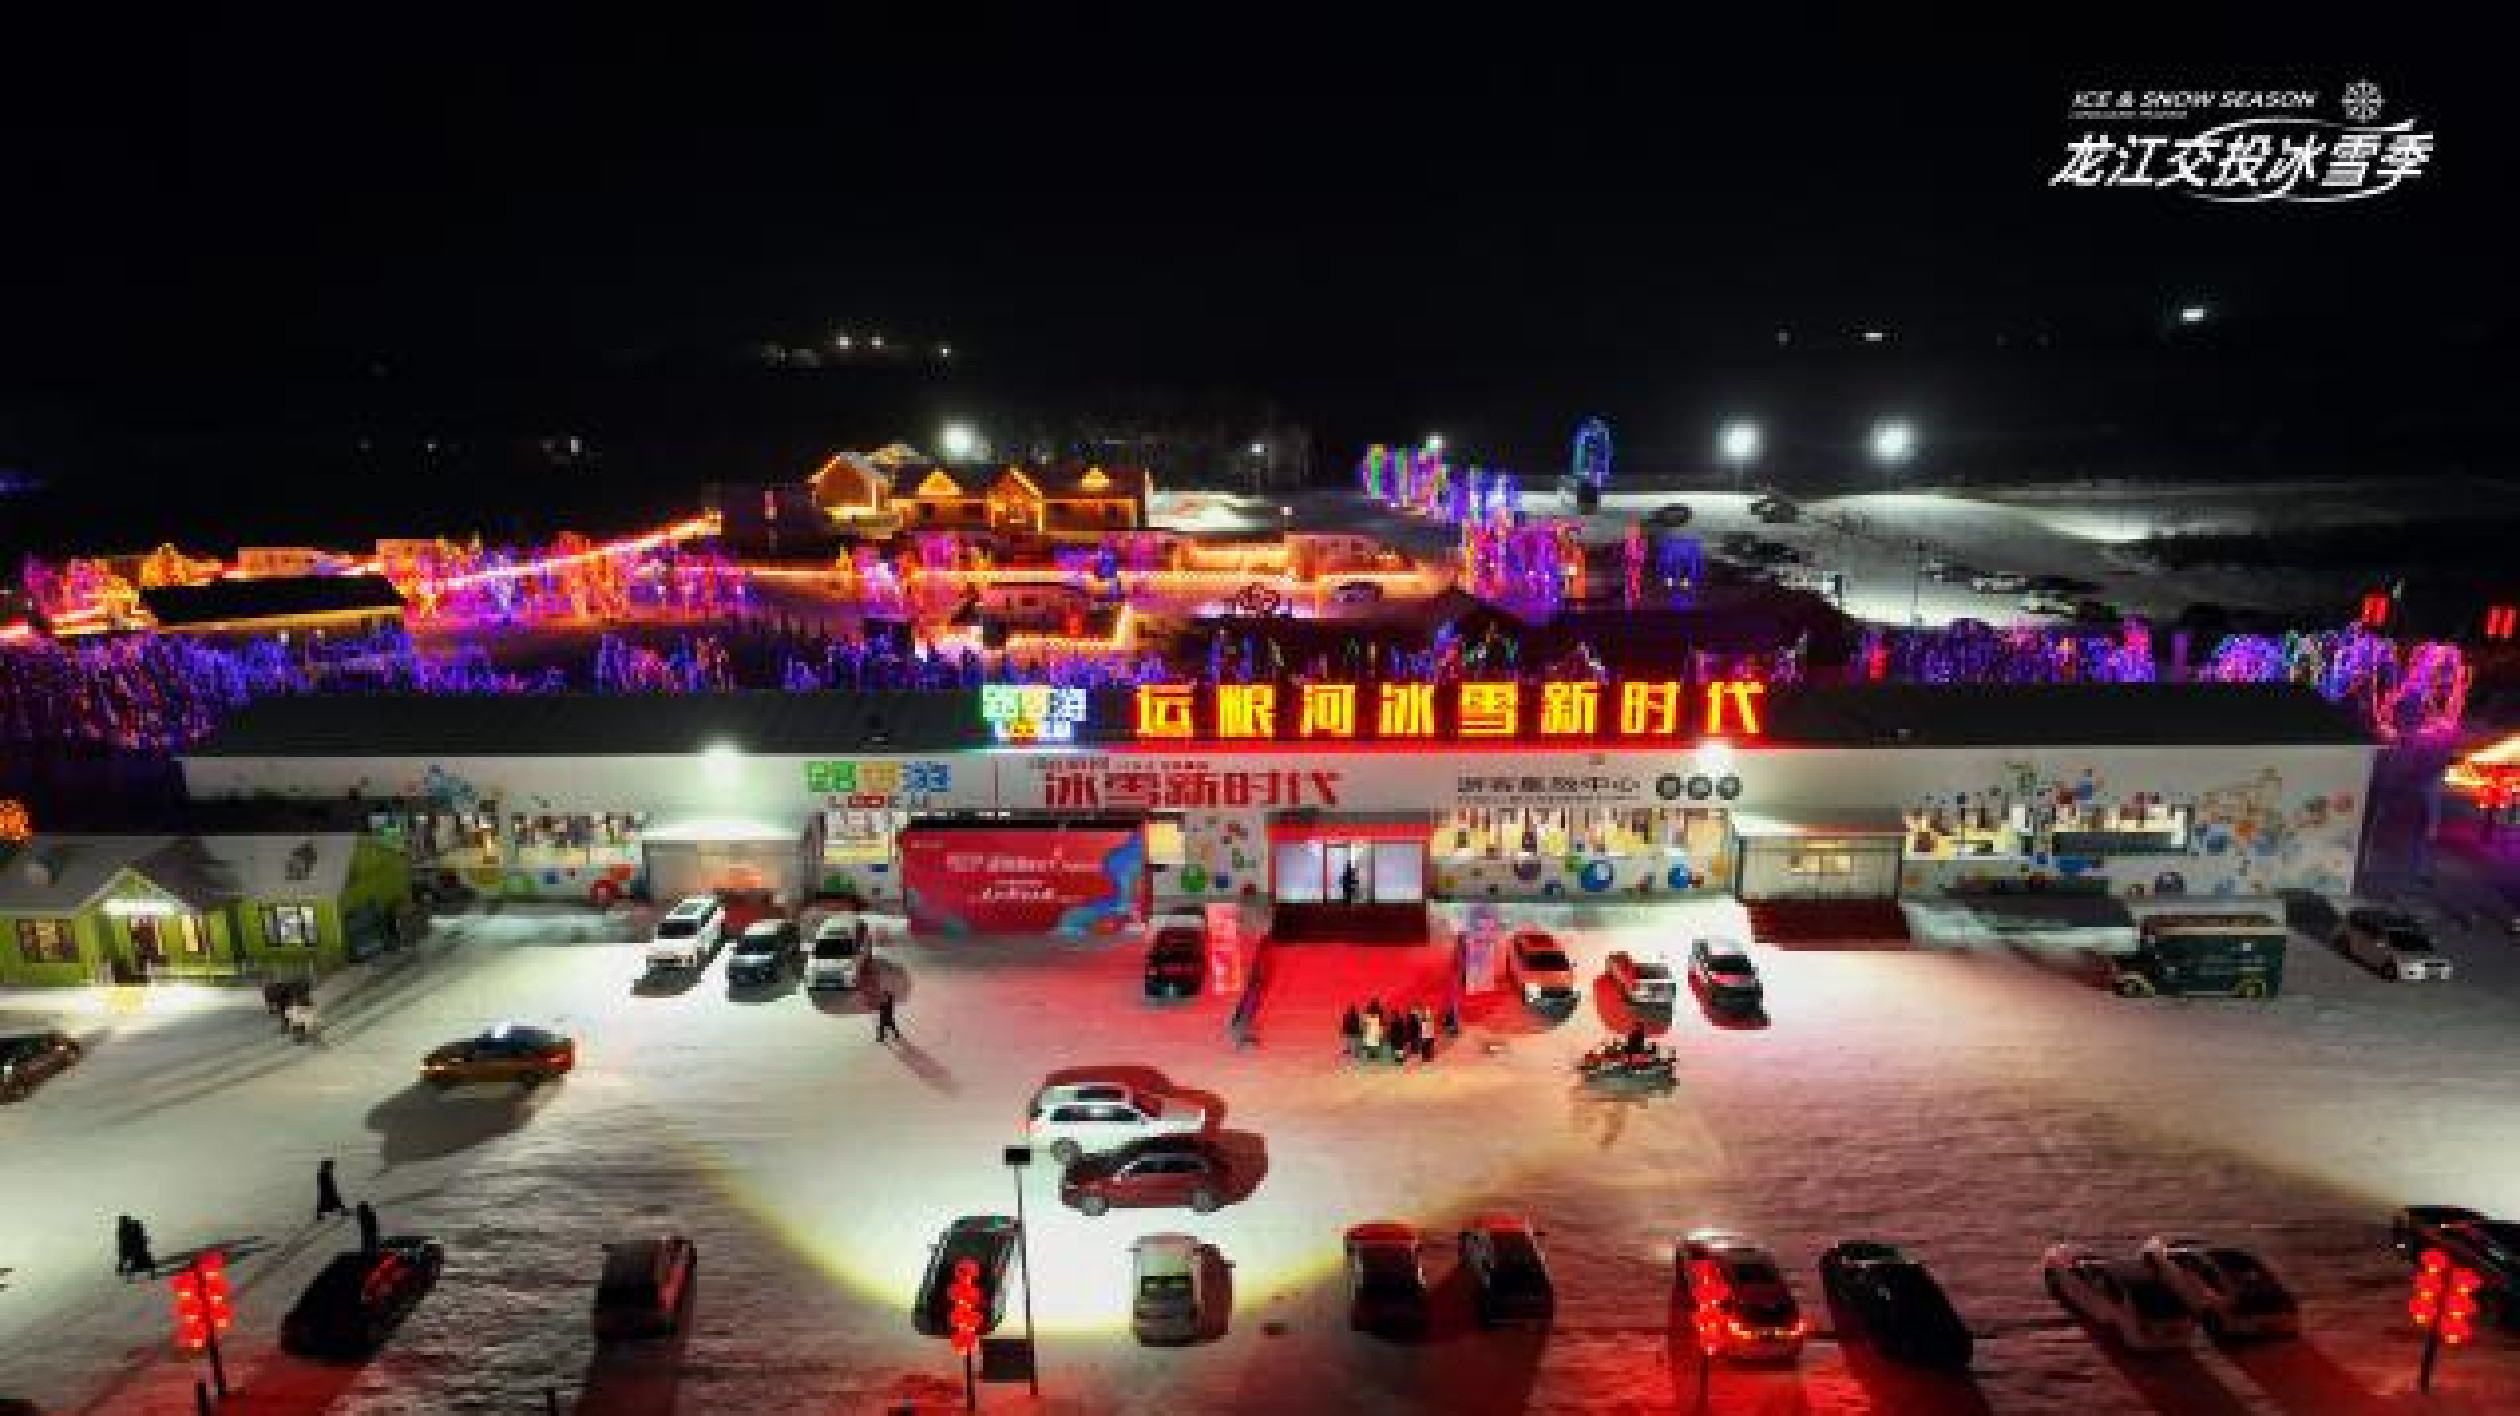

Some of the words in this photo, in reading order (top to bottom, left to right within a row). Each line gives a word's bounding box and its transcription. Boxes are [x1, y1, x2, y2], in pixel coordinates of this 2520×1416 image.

[1045, 771, 1341, 807] 冰雪新时代
